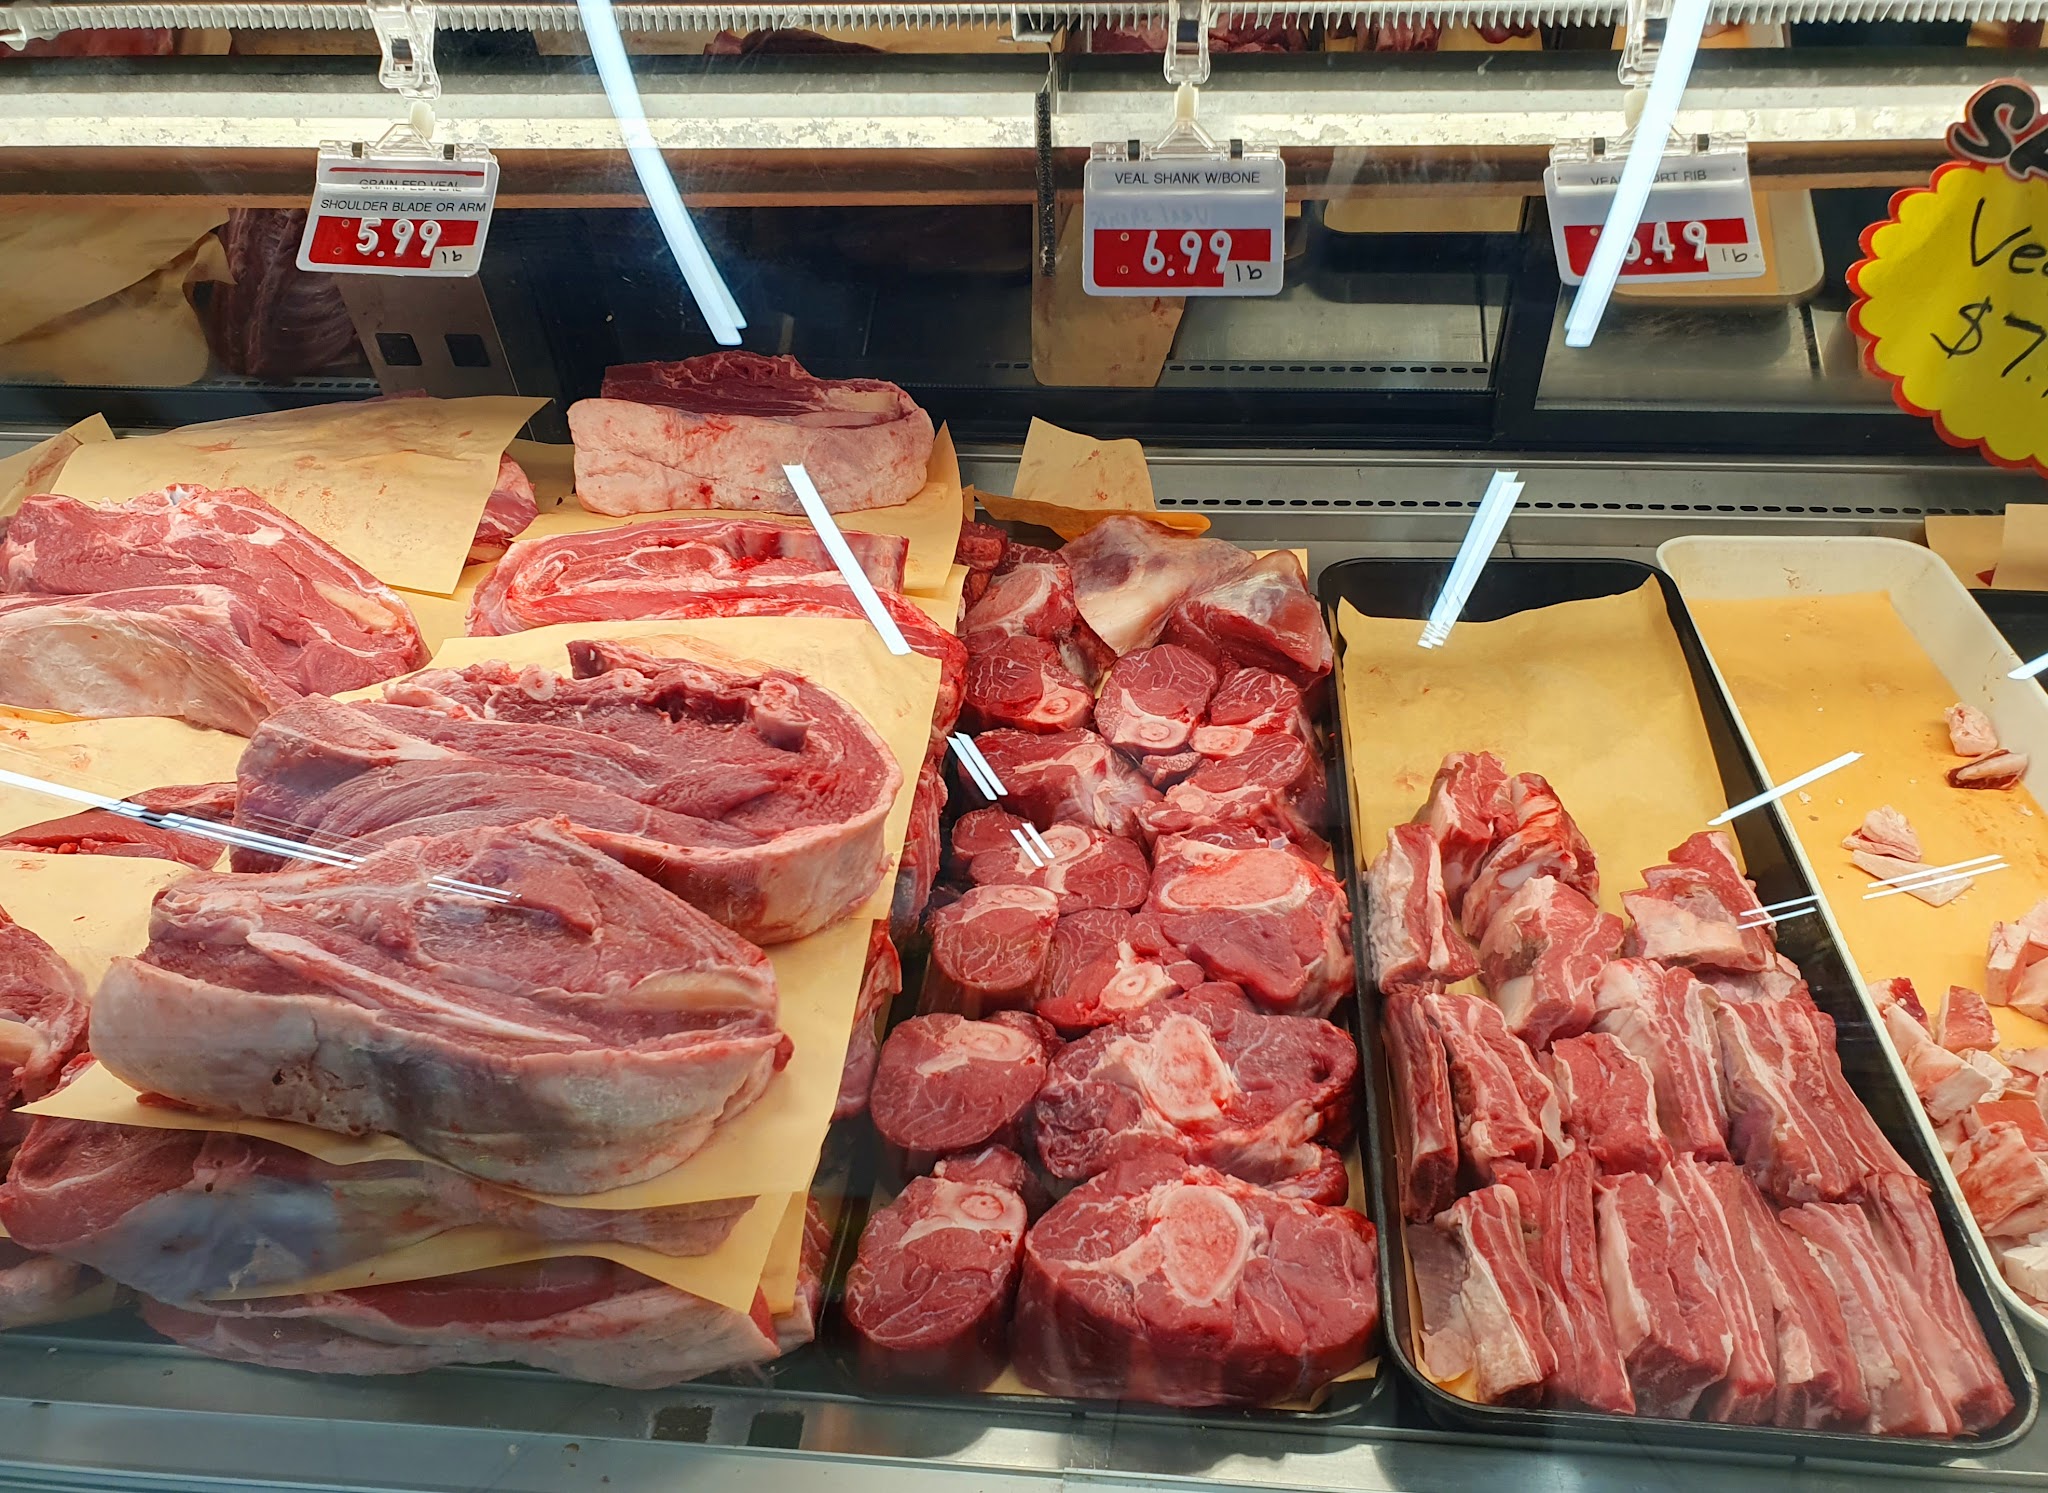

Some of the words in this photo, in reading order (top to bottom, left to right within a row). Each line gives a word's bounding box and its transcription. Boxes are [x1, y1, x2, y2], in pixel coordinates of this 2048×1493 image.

[1115, 172, 1149, 184] VEAL
[1154, 171, 1200, 185] SHANK
[1205, 171, 1261, 184] W/BONE
[1683, 169, 1707, 182] RIB
[359, 179, 398, 191] GRAIN
[402, 180, 427, 191] FED
[320, 199, 388, 212] SHOULDER
[392, 202, 432, 212] BLADE
[436, 202, 455, 212] OR
[458, 203, 486, 213] ARM
[355, 217, 442, 258] 5.99
[1142, 230, 1233, 277] 6.99
[1930, 296, 2048, 398] $7.
